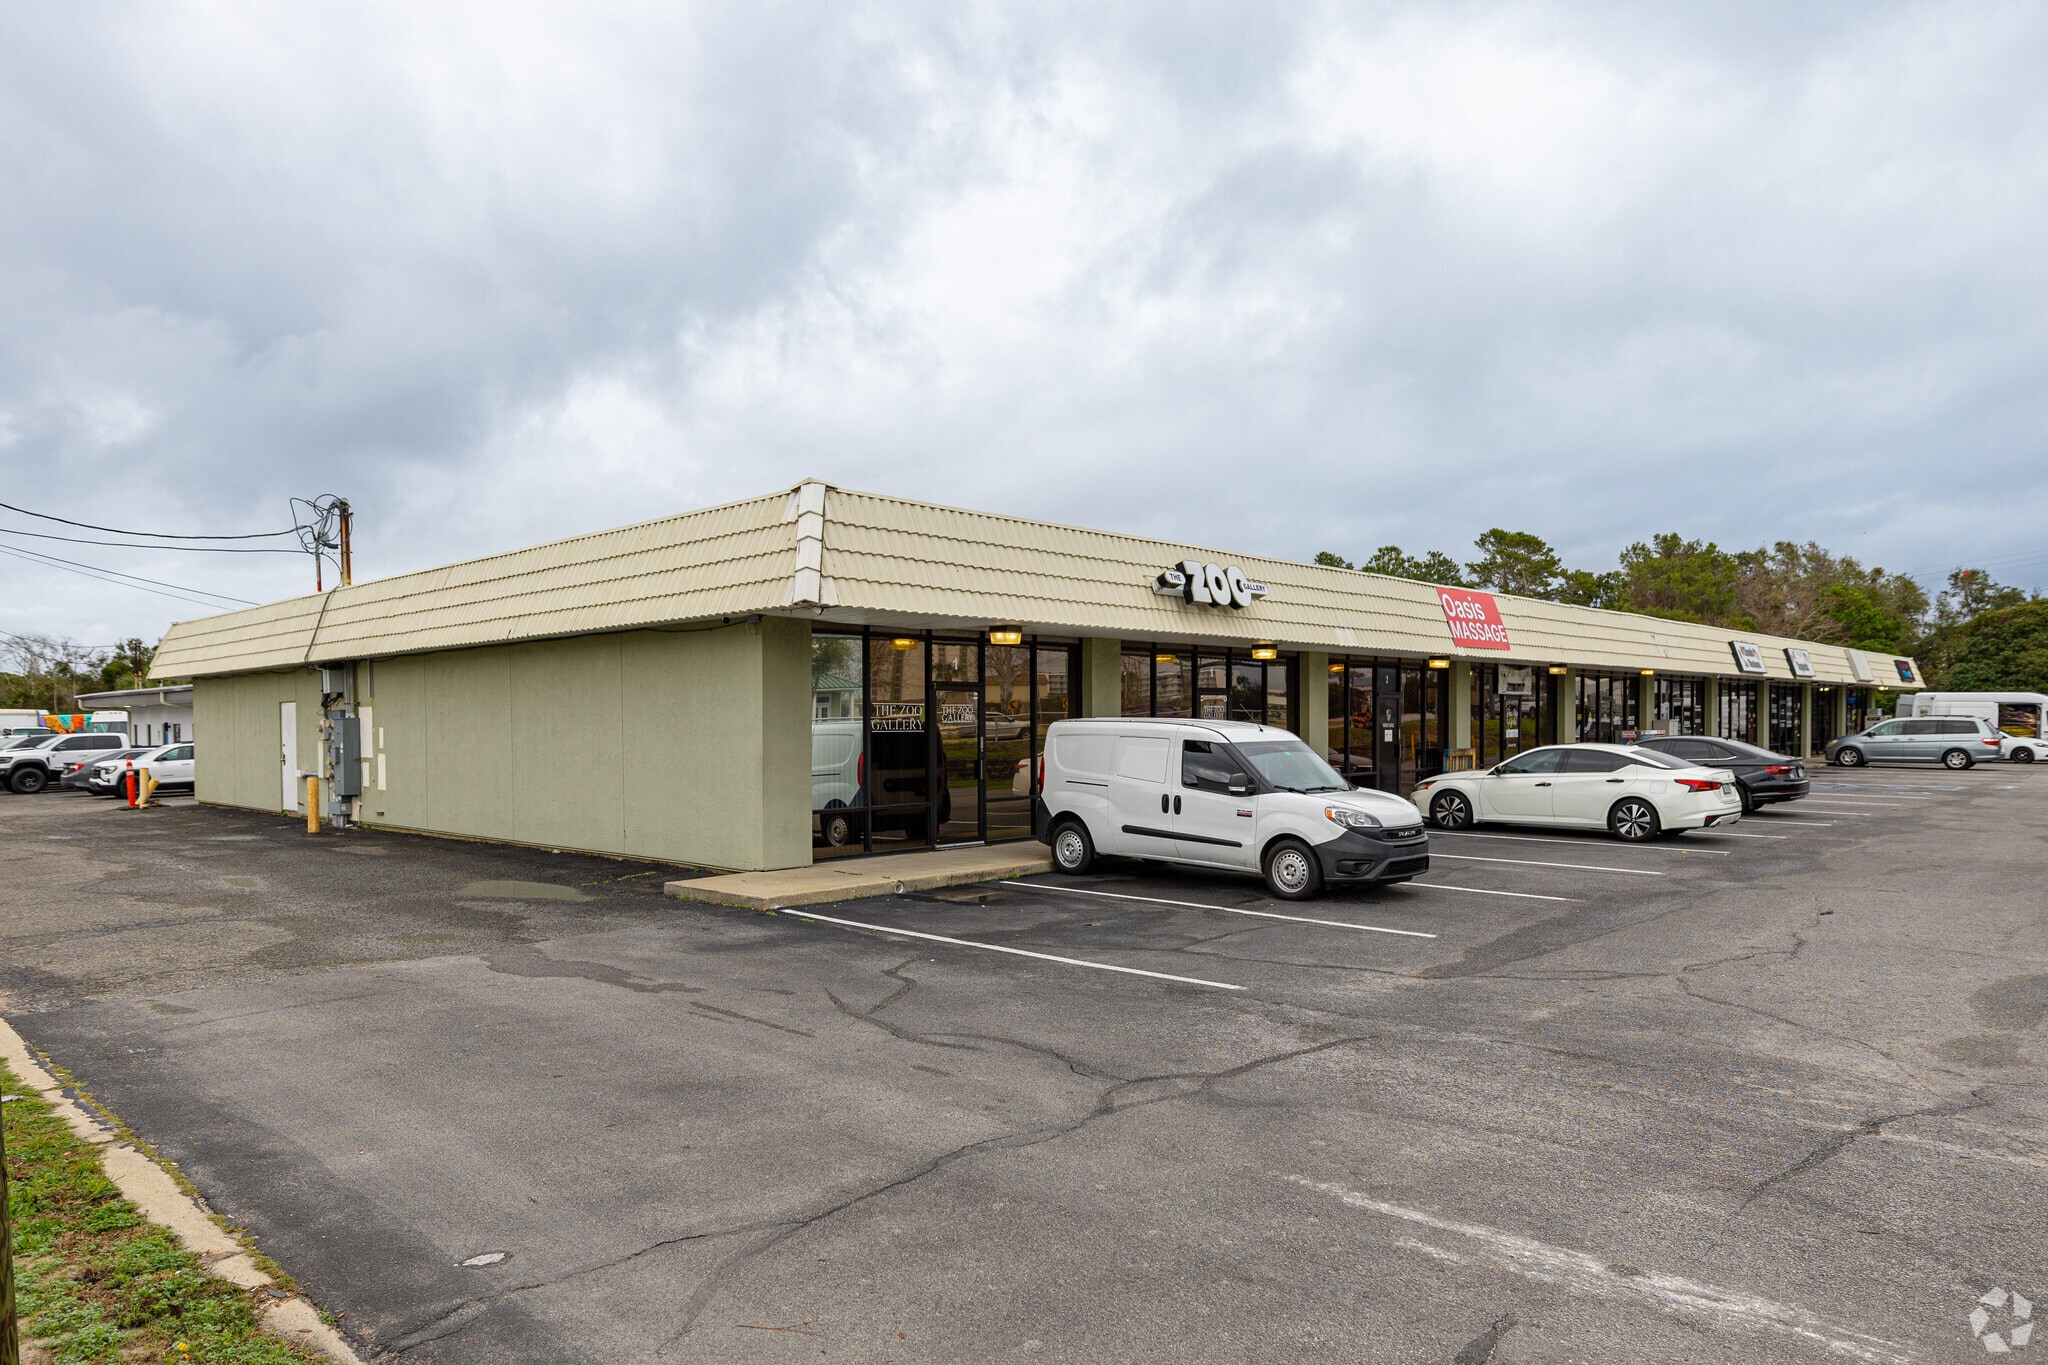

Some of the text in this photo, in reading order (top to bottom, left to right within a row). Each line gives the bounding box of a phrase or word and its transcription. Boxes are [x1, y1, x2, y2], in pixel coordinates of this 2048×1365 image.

[1168, 573, 1182, 582] THE
[1181, 560, 1252, 607] ZOO
[1243, 582, 1266, 592] GALLERY
[1441, 593, 1486, 621] Oasis
[1449, 620, 1508, 643] MASSAGE
[873, 704, 923, 716] THE ZOO
[942, 706, 974, 714] THE ZOO
[942, 713, 973, 721] GALLERY
[871, 718, 923, 730] GALLERY
